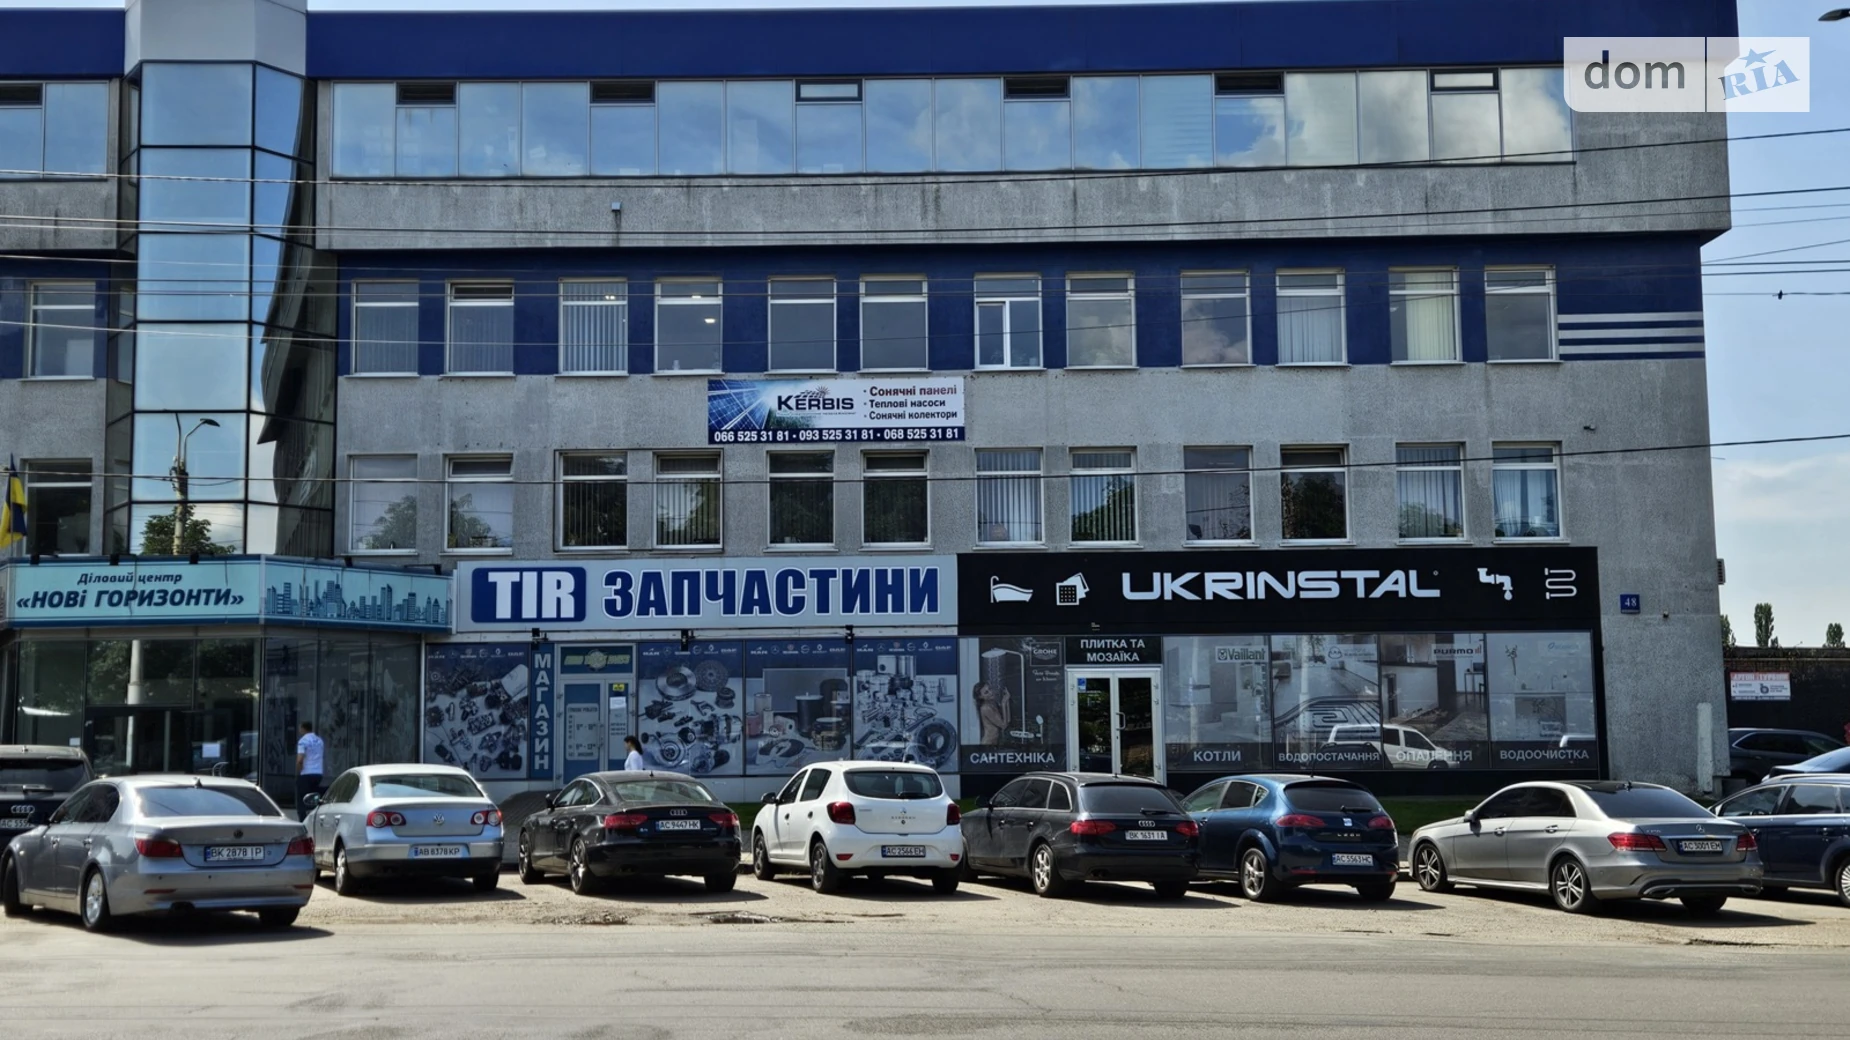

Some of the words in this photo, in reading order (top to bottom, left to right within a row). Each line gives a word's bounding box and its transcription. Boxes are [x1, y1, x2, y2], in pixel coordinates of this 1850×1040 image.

[870, 386, 916, 397] Сонячні
[919, 385, 957, 396] панелі
[778, 394, 854, 411] KERBIS
[869, 399, 907, 409] Теплові
[910, 400, 945, 408] насоси
[869, 411, 906, 421] Сонячні
[908, 410, 957, 421] колектори
[714, 431, 735, 442] 066
[737, 431, 758, 442] 525
[760, 431, 773, 442] 31
[776, 431, 789, 441] 81
[799, 430, 820, 441] 093
[822, 430, 842, 441] 525
[845, 430, 858, 440] 31
[861, 430, 874, 440] 81
[883, 430, 904, 440] 068
[907, 429, 927, 440] 525
[929, 429, 942, 440] 31
[946, 429, 959, 439] 81
[77, 572, 134, 585] Діловий
[138, 573, 182, 584] центр
[1122, 569, 1441, 600] UKRINSTAL
[94, 588, 245, 608] ГОРИЗОНТИ»
[488, 571, 575, 619] TIR
[602, 567, 941, 618] ЗАПЧАСТИНИ
[1624, 597, 1637, 607] 48
[1080, 639, 1128, 649] ПЛИТКА
[1130, 638, 1146, 648] ТА
[1086, 650, 1140, 662] МОЗАЇКА
[1228, 647, 1266, 661] Vaillant
[534, 653, 552, 770] МАГАЗИН
[969, 752, 1056, 764] САНТЕХНІКА
[1193, 750, 1241, 762] КОТЛИ
[1278, 751, 1381, 763] ВОДОПОСТАЧАННЯ
[1396, 750, 1473, 762] ОПАЛЕННЯ
[1499, 749, 1590, 761] ВОДООЧИСТКА
[211, 848, 224, 858] BK
